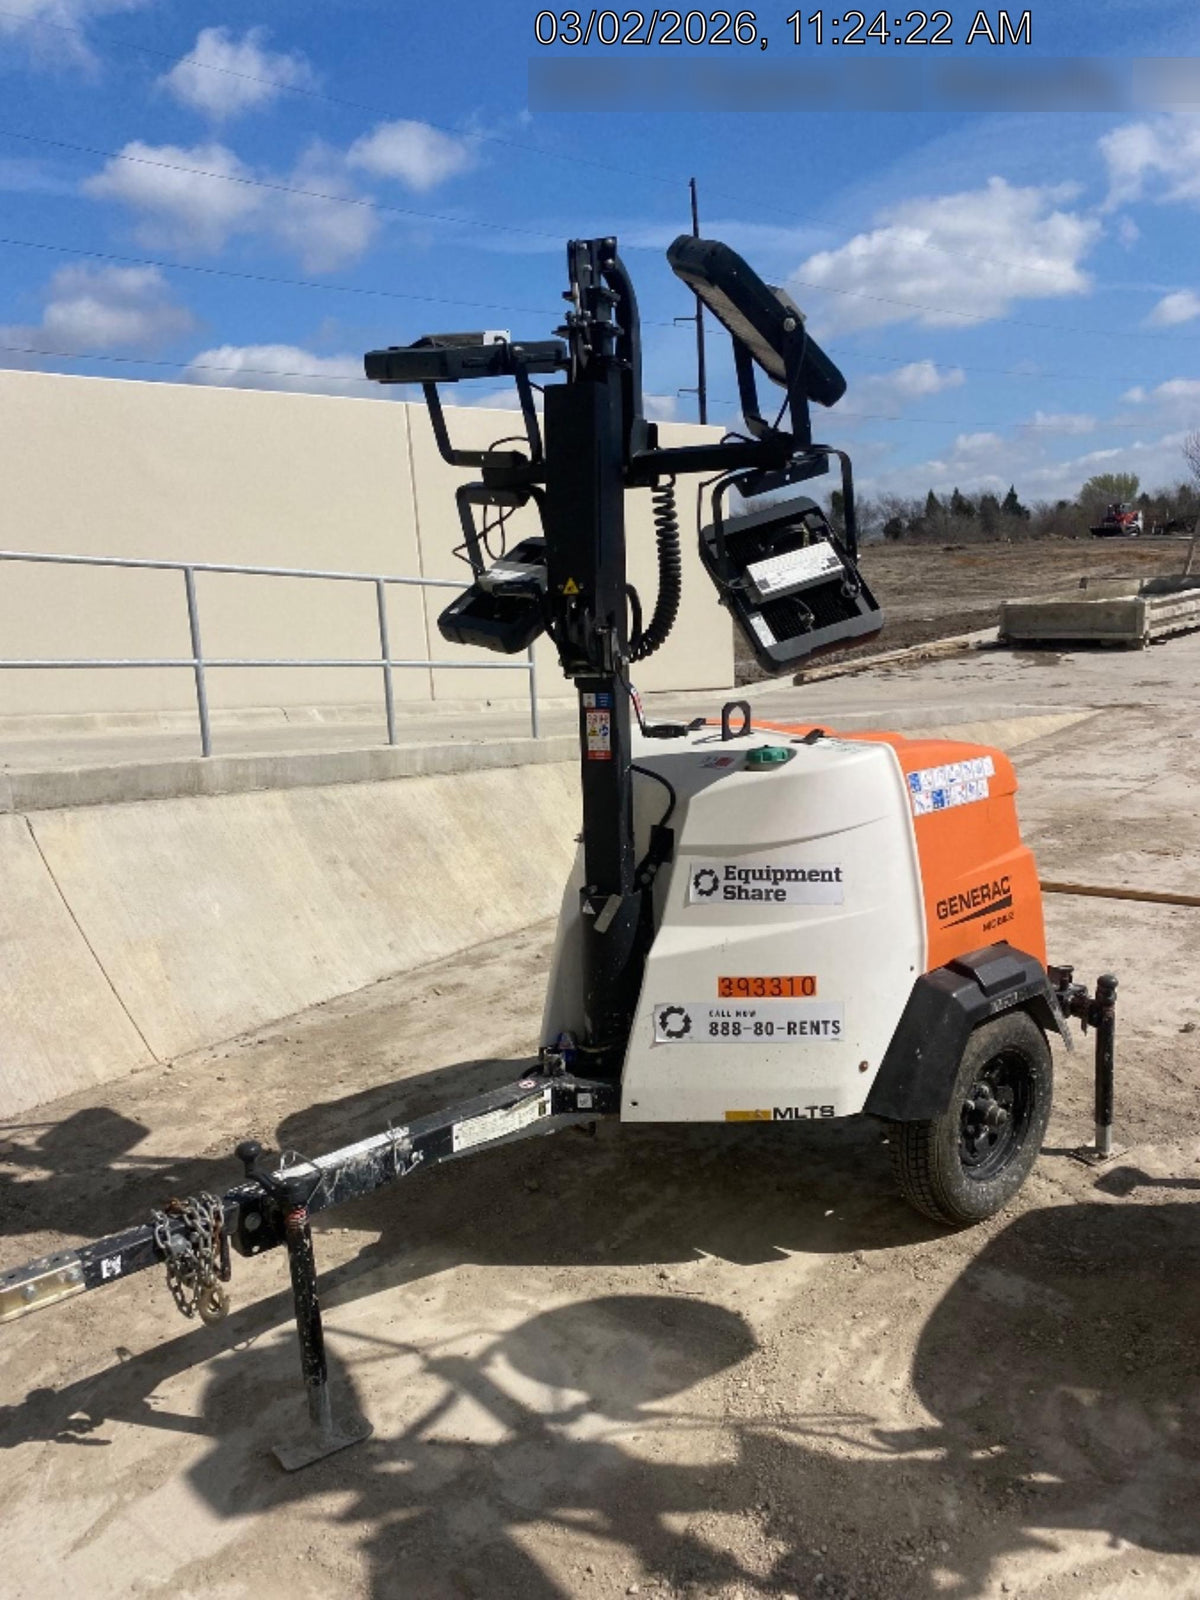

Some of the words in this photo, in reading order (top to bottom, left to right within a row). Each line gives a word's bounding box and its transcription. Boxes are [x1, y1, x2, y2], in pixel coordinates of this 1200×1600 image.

[724, 865, 843, 885] Equipment
[723, 885, 787, 901] Share
[936, 875, 1012, 920] GENERAC
[720, 976, 816, 998] 393310
[708, 1010, 732, 1018] CALL
[708, 1020, 841, 1036] 888-80-RENTS
